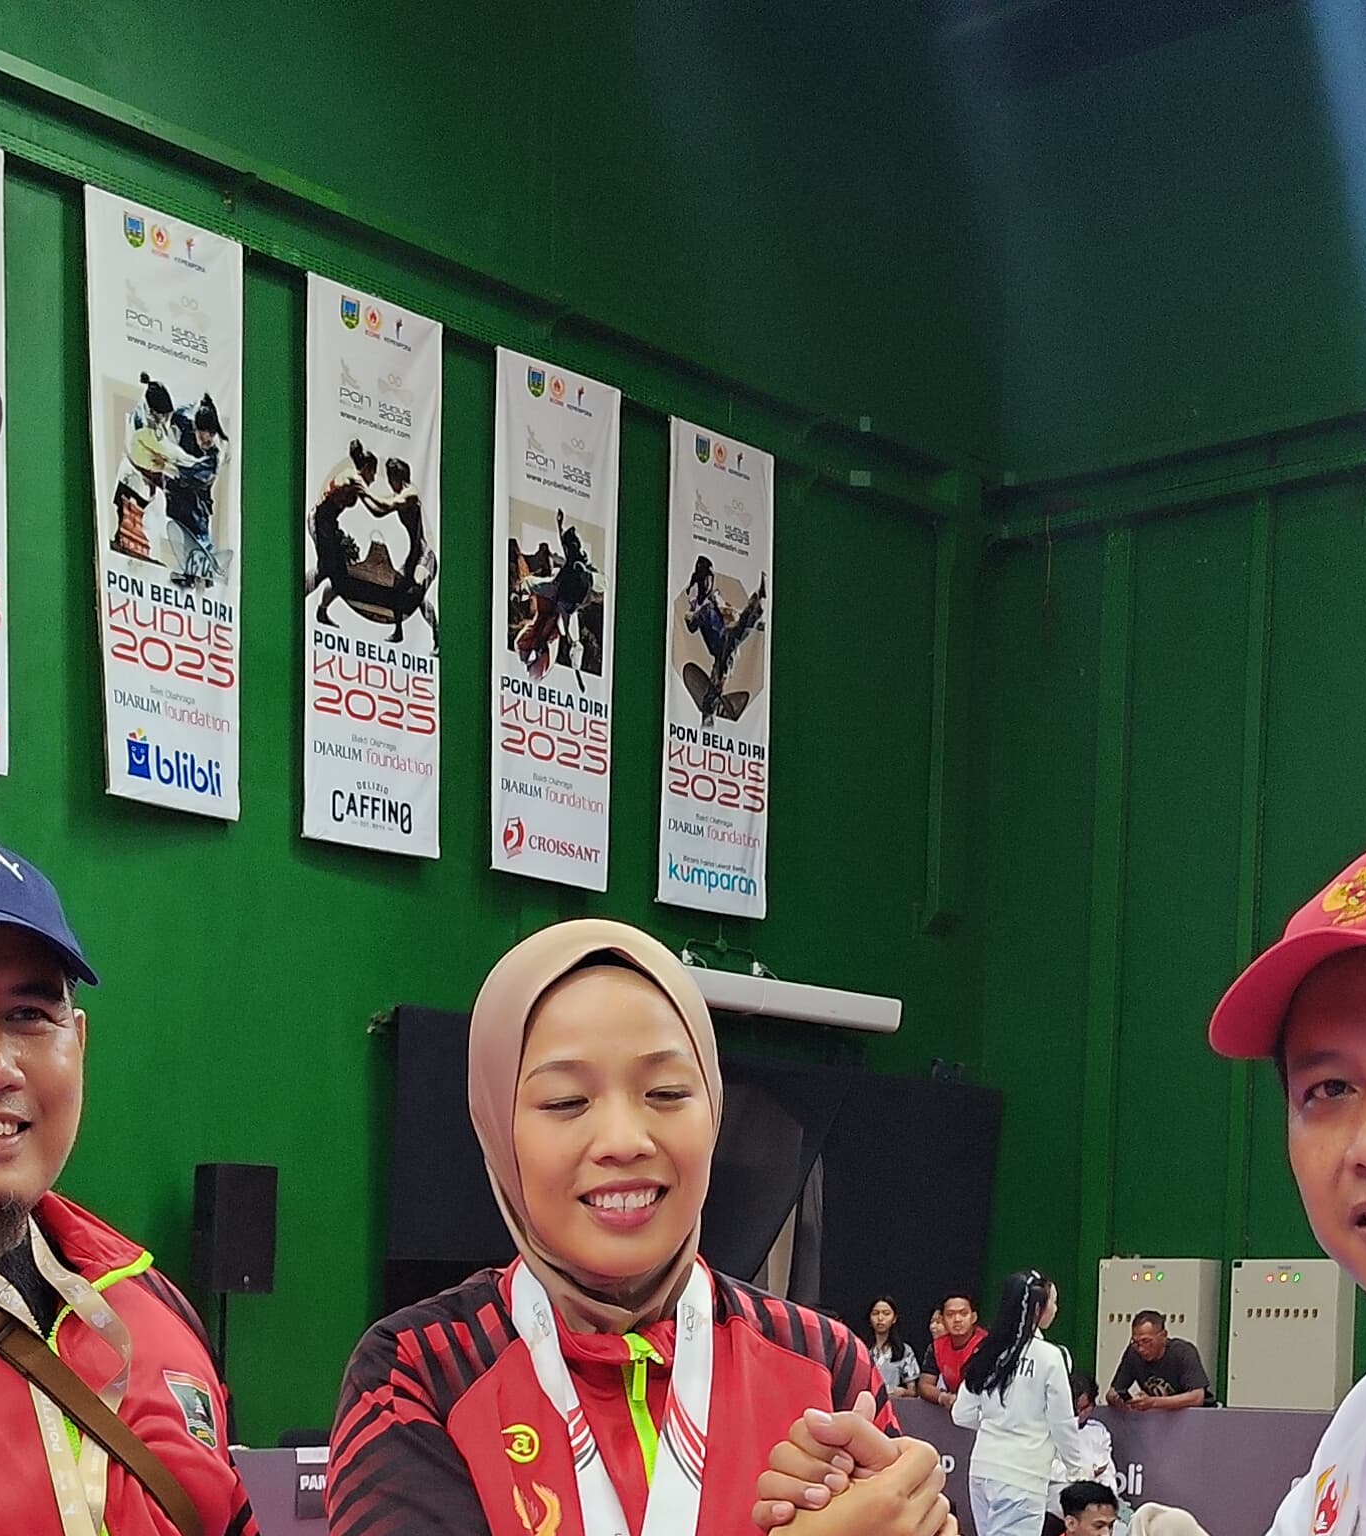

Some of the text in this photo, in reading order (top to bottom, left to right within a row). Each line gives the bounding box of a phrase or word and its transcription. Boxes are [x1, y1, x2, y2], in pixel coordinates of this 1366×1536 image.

[108, 571, 232, 622] PON BELA DIRI
[109, 592, 233, 650] KUDUS
[110, 624, 234, 688] 2025
[314, 630, 433, 674] PON BELA DIRI
[314, 650, 435, 700] KUDUS
[114, 689, 229, 732] DJARUM foundation
[314, 680, 435, 735] 2025
[501, 676, 608, 719] PON BELA DIRI
[501, 695, 607, 743] KUDUS
[314, 740, 432, 776] DJARUM foundation
[501, 722, 607, 775] 2025
[669, 741, 764, 783] KUDUS
[670, 723, 764, 760] PON BELA DIRI
[156, 745, 221, 797] blibli
[357, 781, 388, 794] DELIZIO
[669, 766, 764, 812] 2025
[332, 790, 412, 834] CAFFINO
[501, 778, 603, 814] DJARUM foundation
[529, 835, 600, 863] CROISSANT
[669, 818, 760, 848] DJARUM foundation
[669, 852, 756, 896] kumparan
